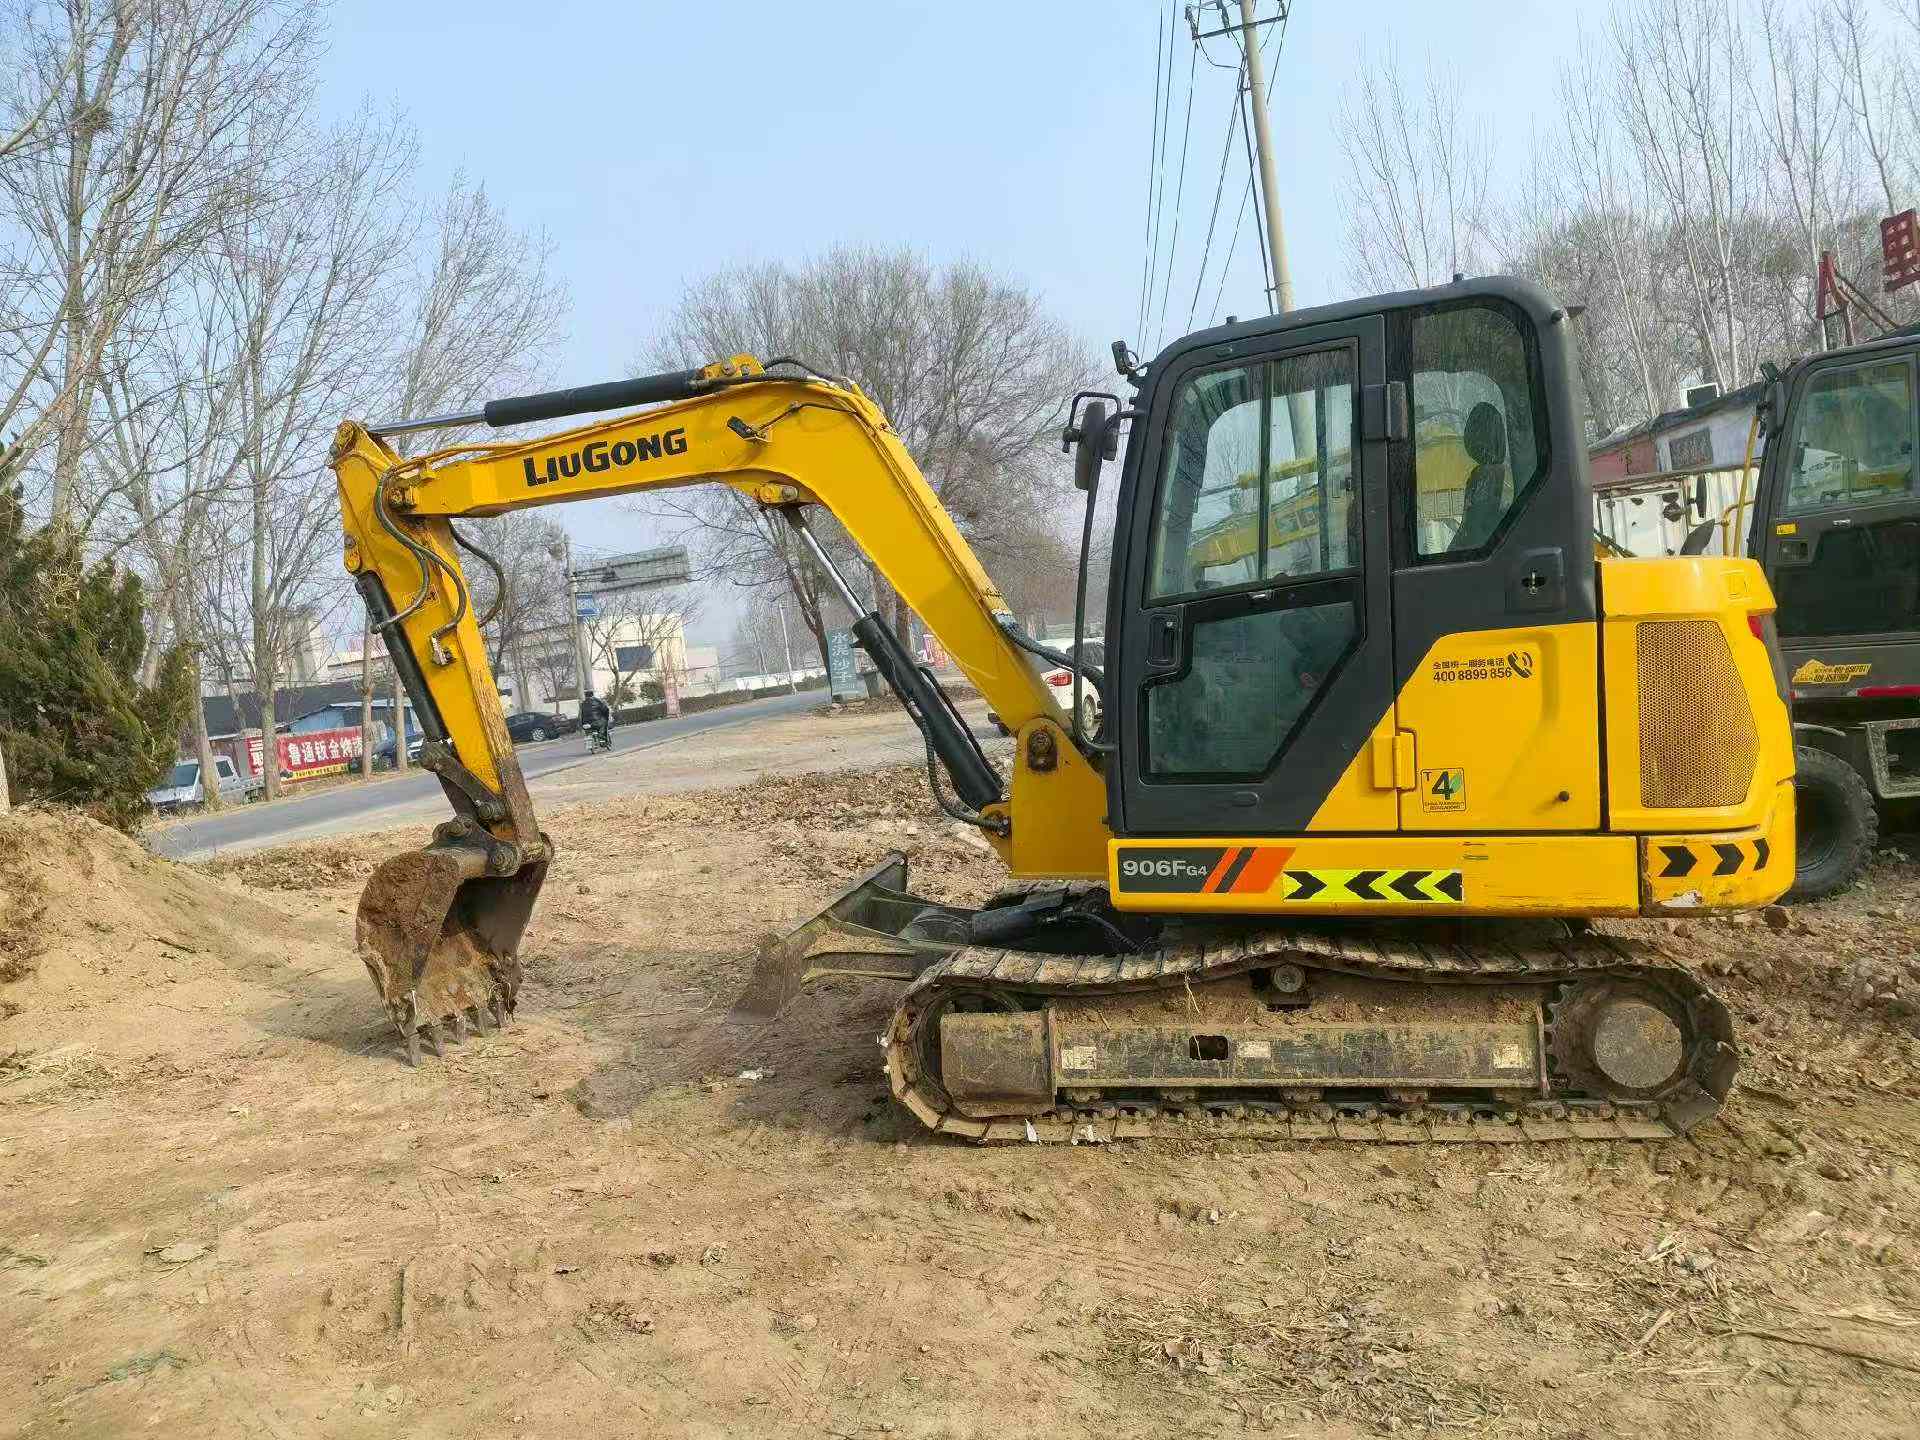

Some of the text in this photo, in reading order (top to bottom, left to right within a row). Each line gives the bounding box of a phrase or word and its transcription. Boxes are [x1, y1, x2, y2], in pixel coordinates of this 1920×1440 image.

[1433, 666, 1513, 682] 400 8899 856
[1431, 770, 1455, 801] 4
